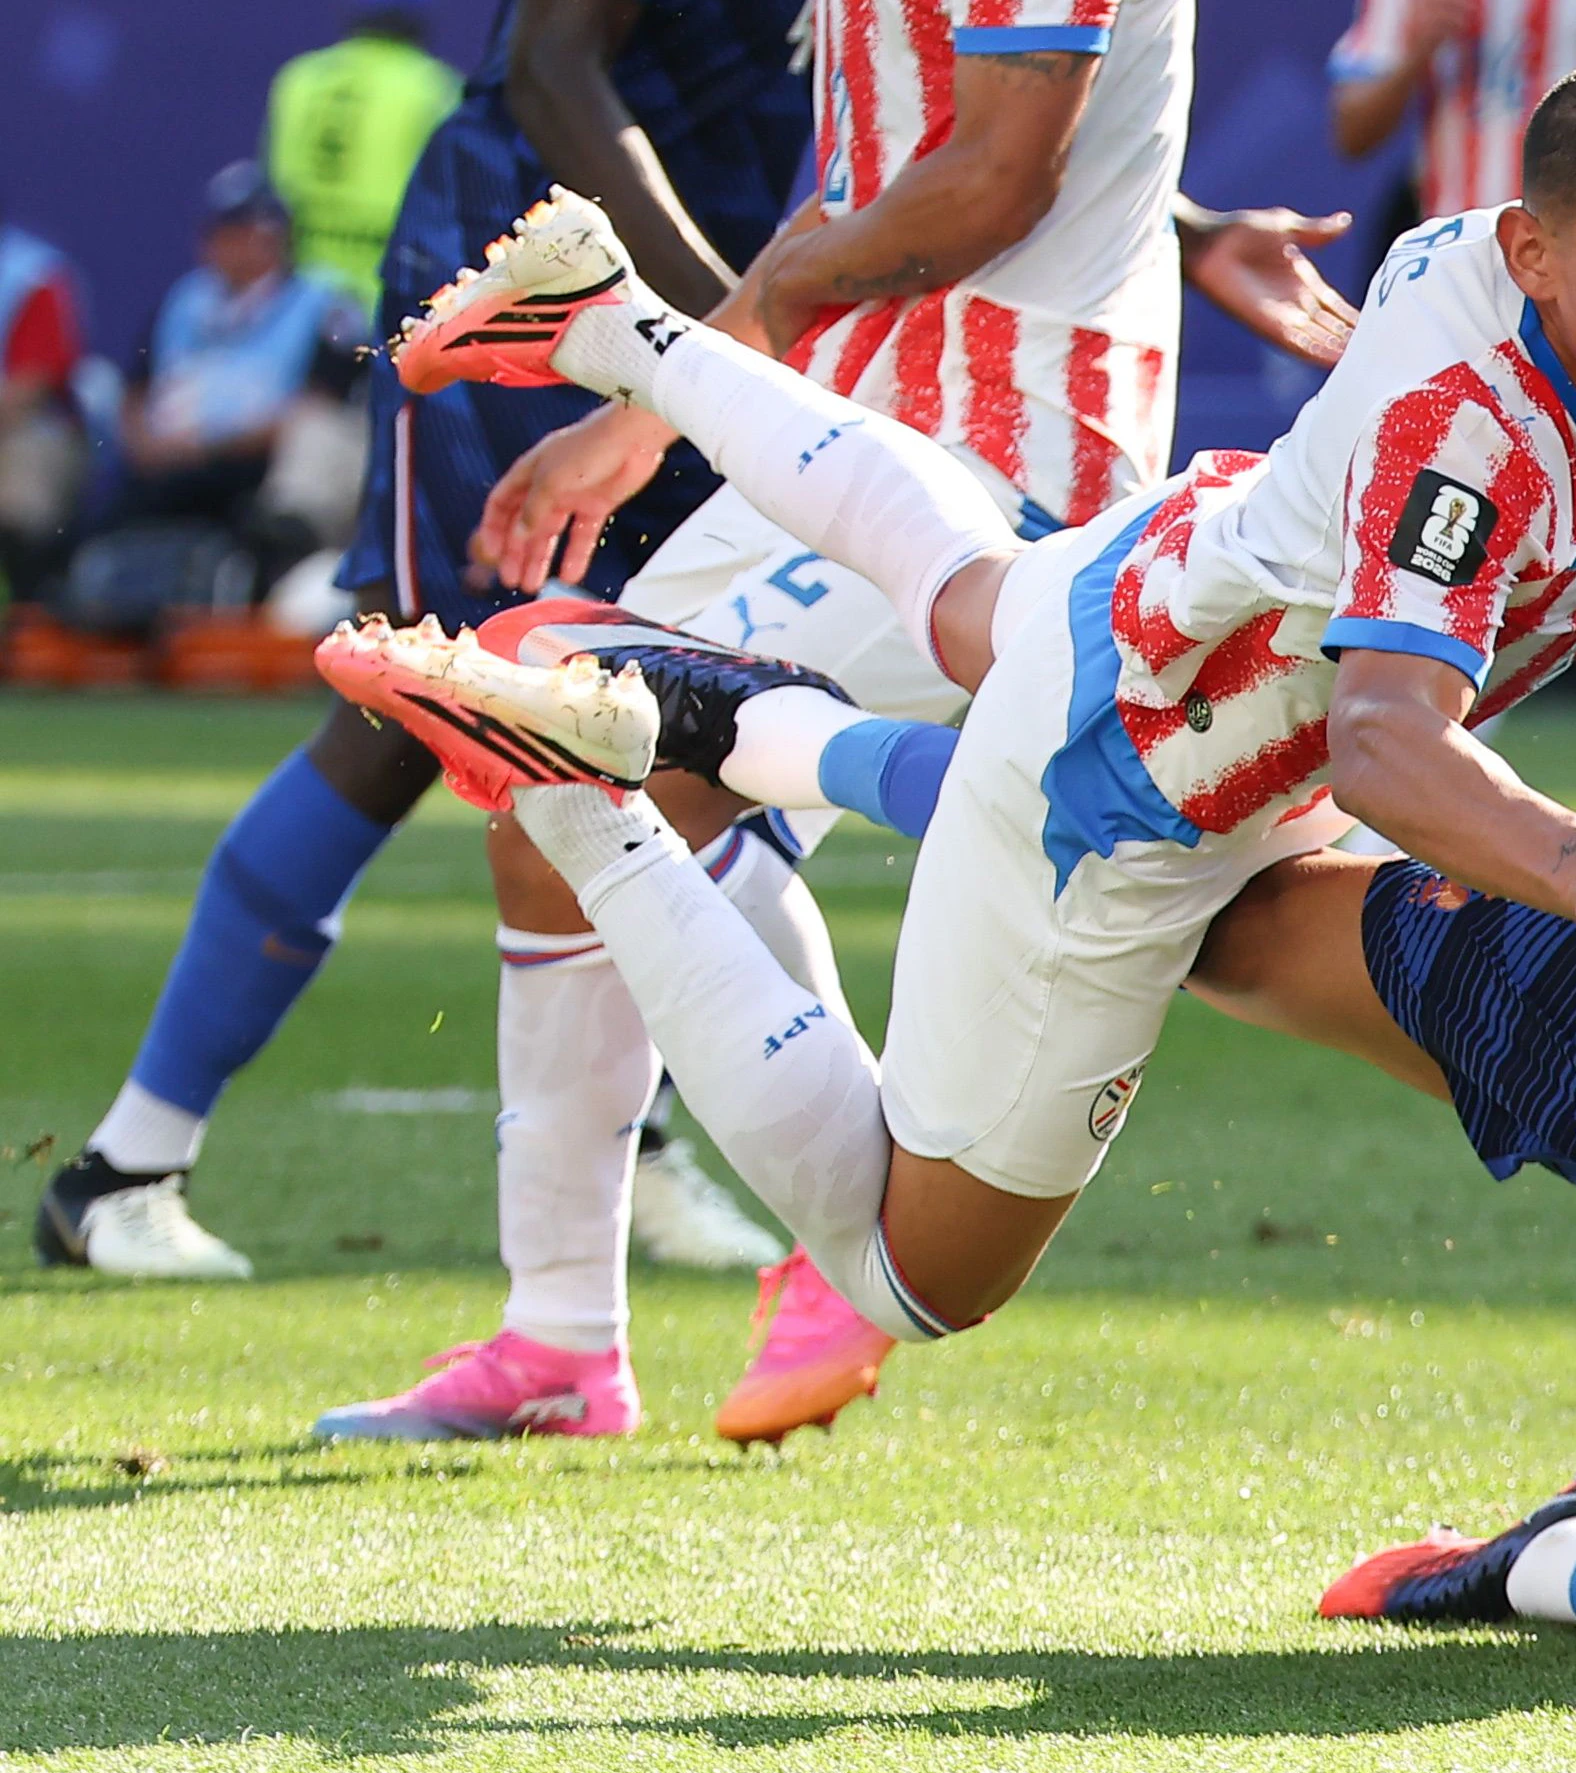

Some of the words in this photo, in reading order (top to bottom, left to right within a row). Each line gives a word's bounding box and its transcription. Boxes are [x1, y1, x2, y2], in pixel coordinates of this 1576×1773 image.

[1433, 536, 1453, 552] FIFA
[1409, 553, 1452, 582] 2026
[1415, 545, 1443, 563] WORLD
[1441, 558, 1456, 571] CUP
